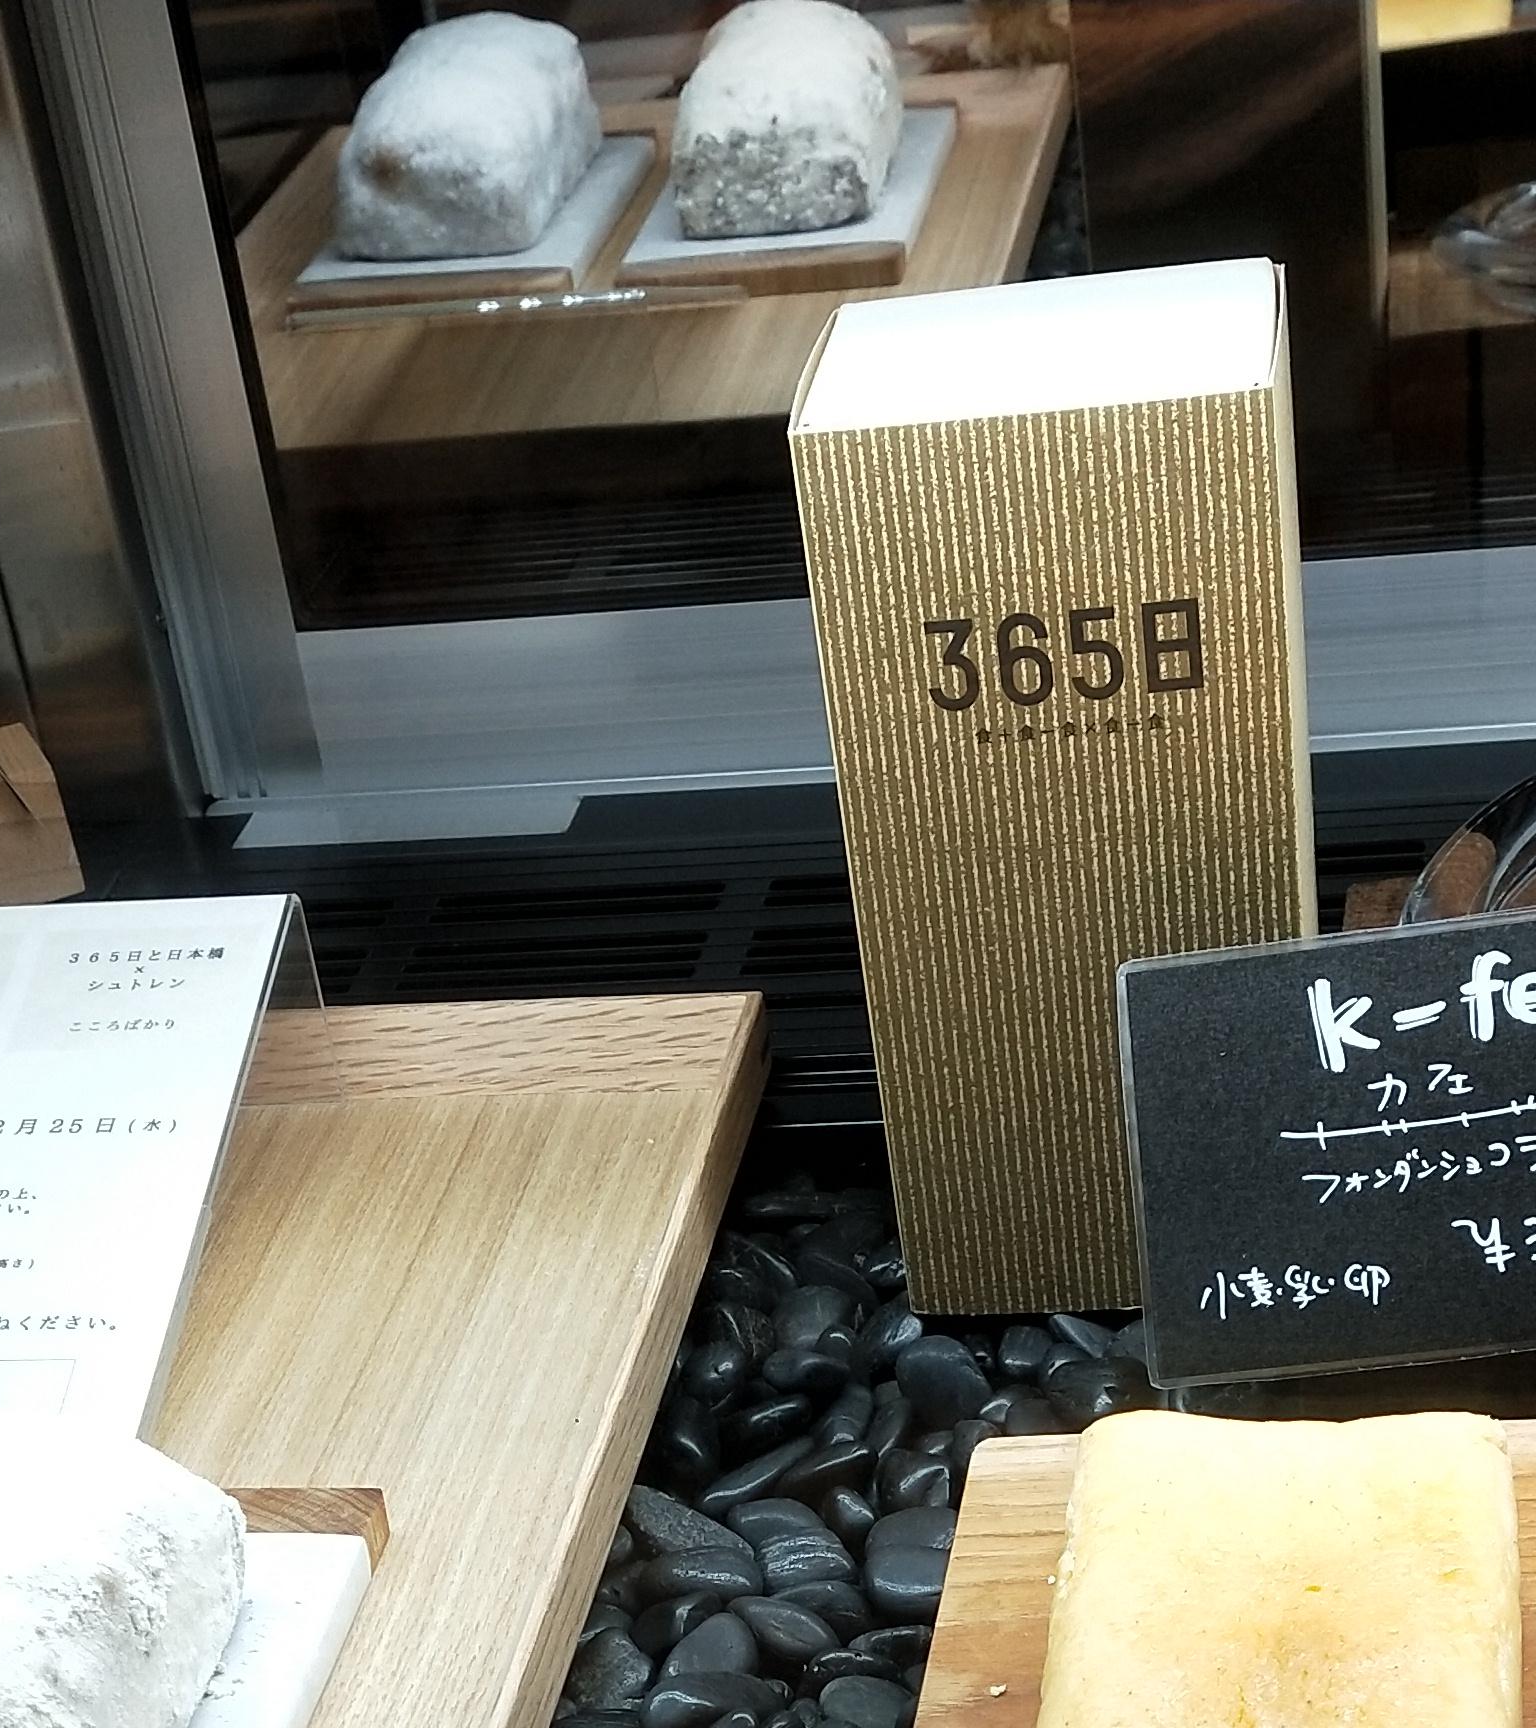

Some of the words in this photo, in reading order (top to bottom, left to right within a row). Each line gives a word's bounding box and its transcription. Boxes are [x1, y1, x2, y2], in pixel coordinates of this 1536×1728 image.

[923, 597, 1204, 712] 365日
[68, 947, 225, 964] 365日と日本橋
[88, 977, 186, 992] シュトレン
[69, 1018, 177, 1032] こころばかり
[1368, 1063, 1475, 1112] カフェ
